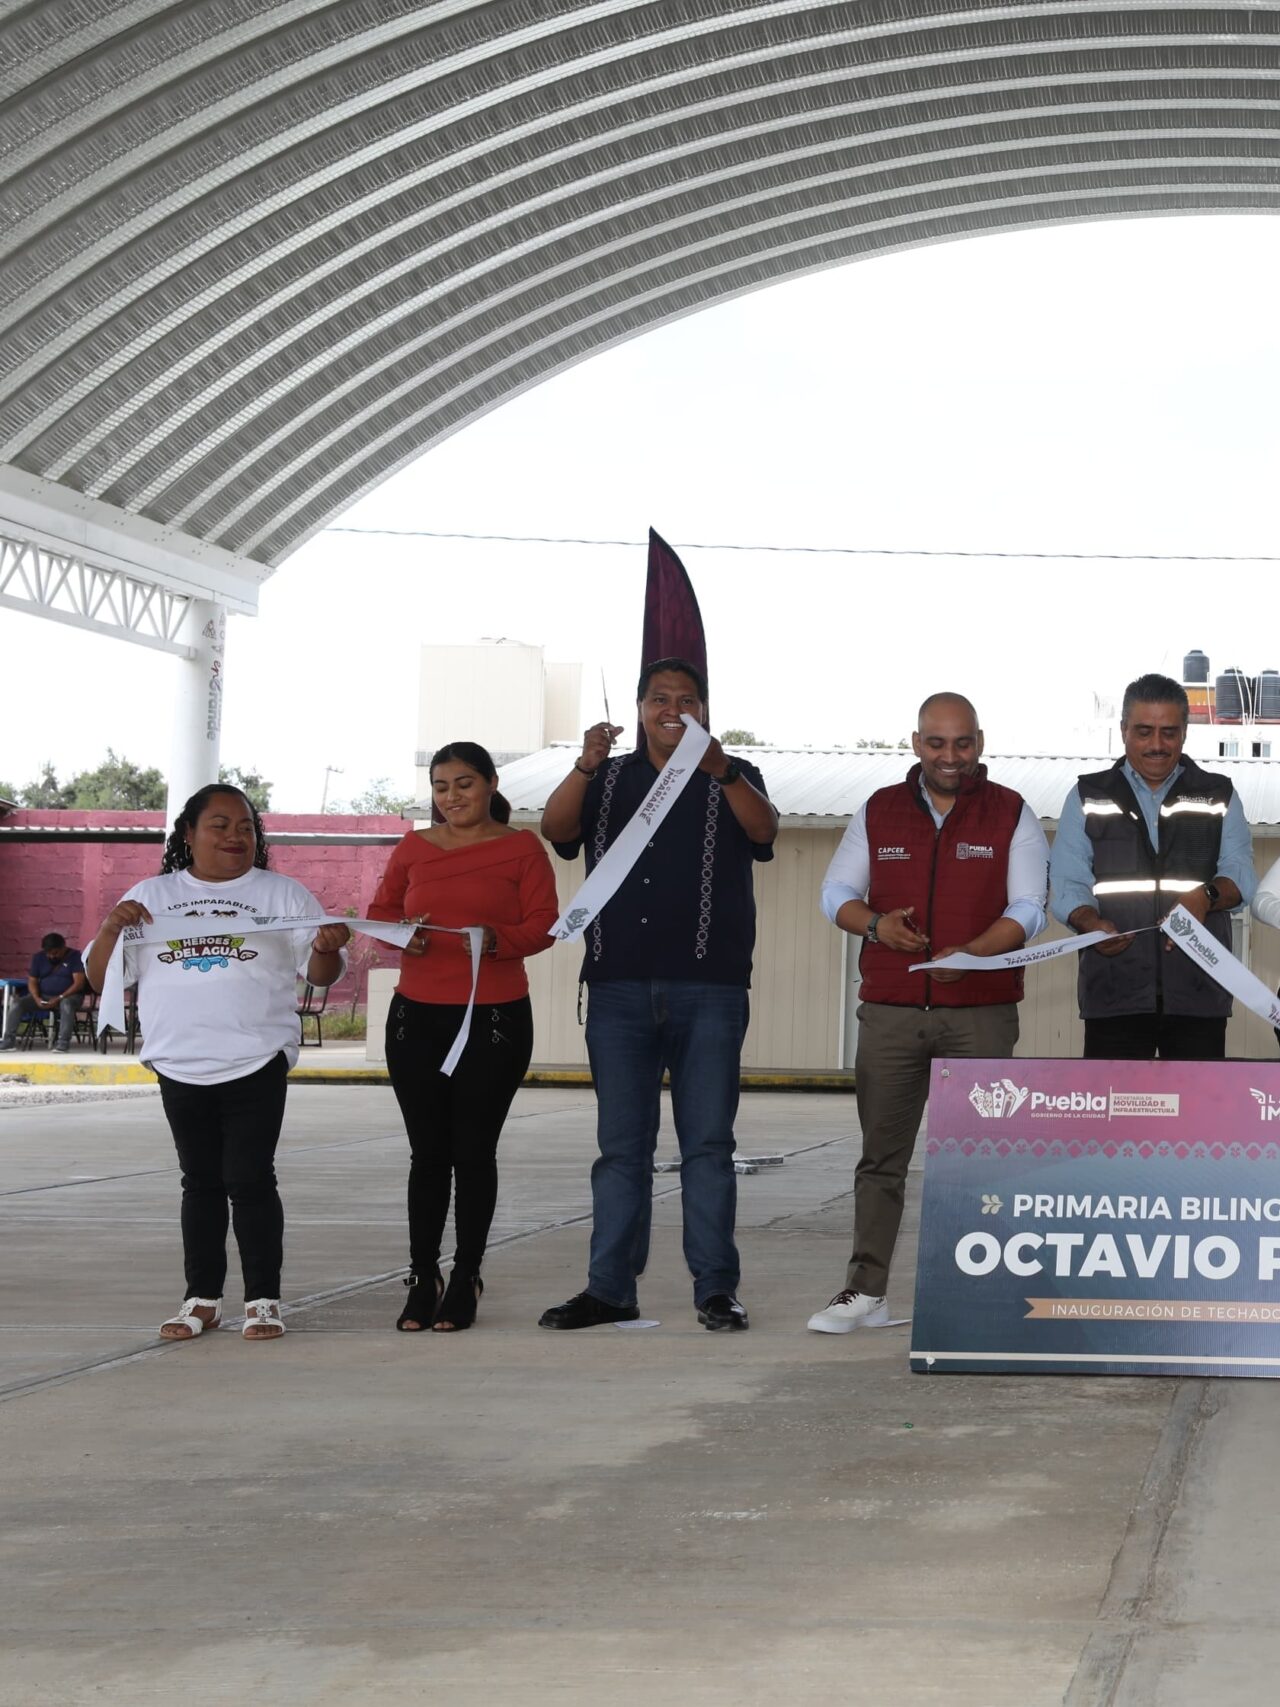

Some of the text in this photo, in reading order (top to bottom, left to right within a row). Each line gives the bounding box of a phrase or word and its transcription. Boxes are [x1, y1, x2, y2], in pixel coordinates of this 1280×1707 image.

[639, 767, 676, 818] IMPARABLE
[167, 899, 258, 914] LOS IMPARABLES
[174, 947, 238, 960] DEL AGUA
[1031, 1092, 1106, 1110] Puebla
[1013, 1194, 1172, 1220] PRIMARIA
[954, 1232, 1240, 1280] OCTAVIO
[1051, 1302, 1176, 1318] INAUGURACIÓN
[1181, 1306, 1202, 1319] DE
